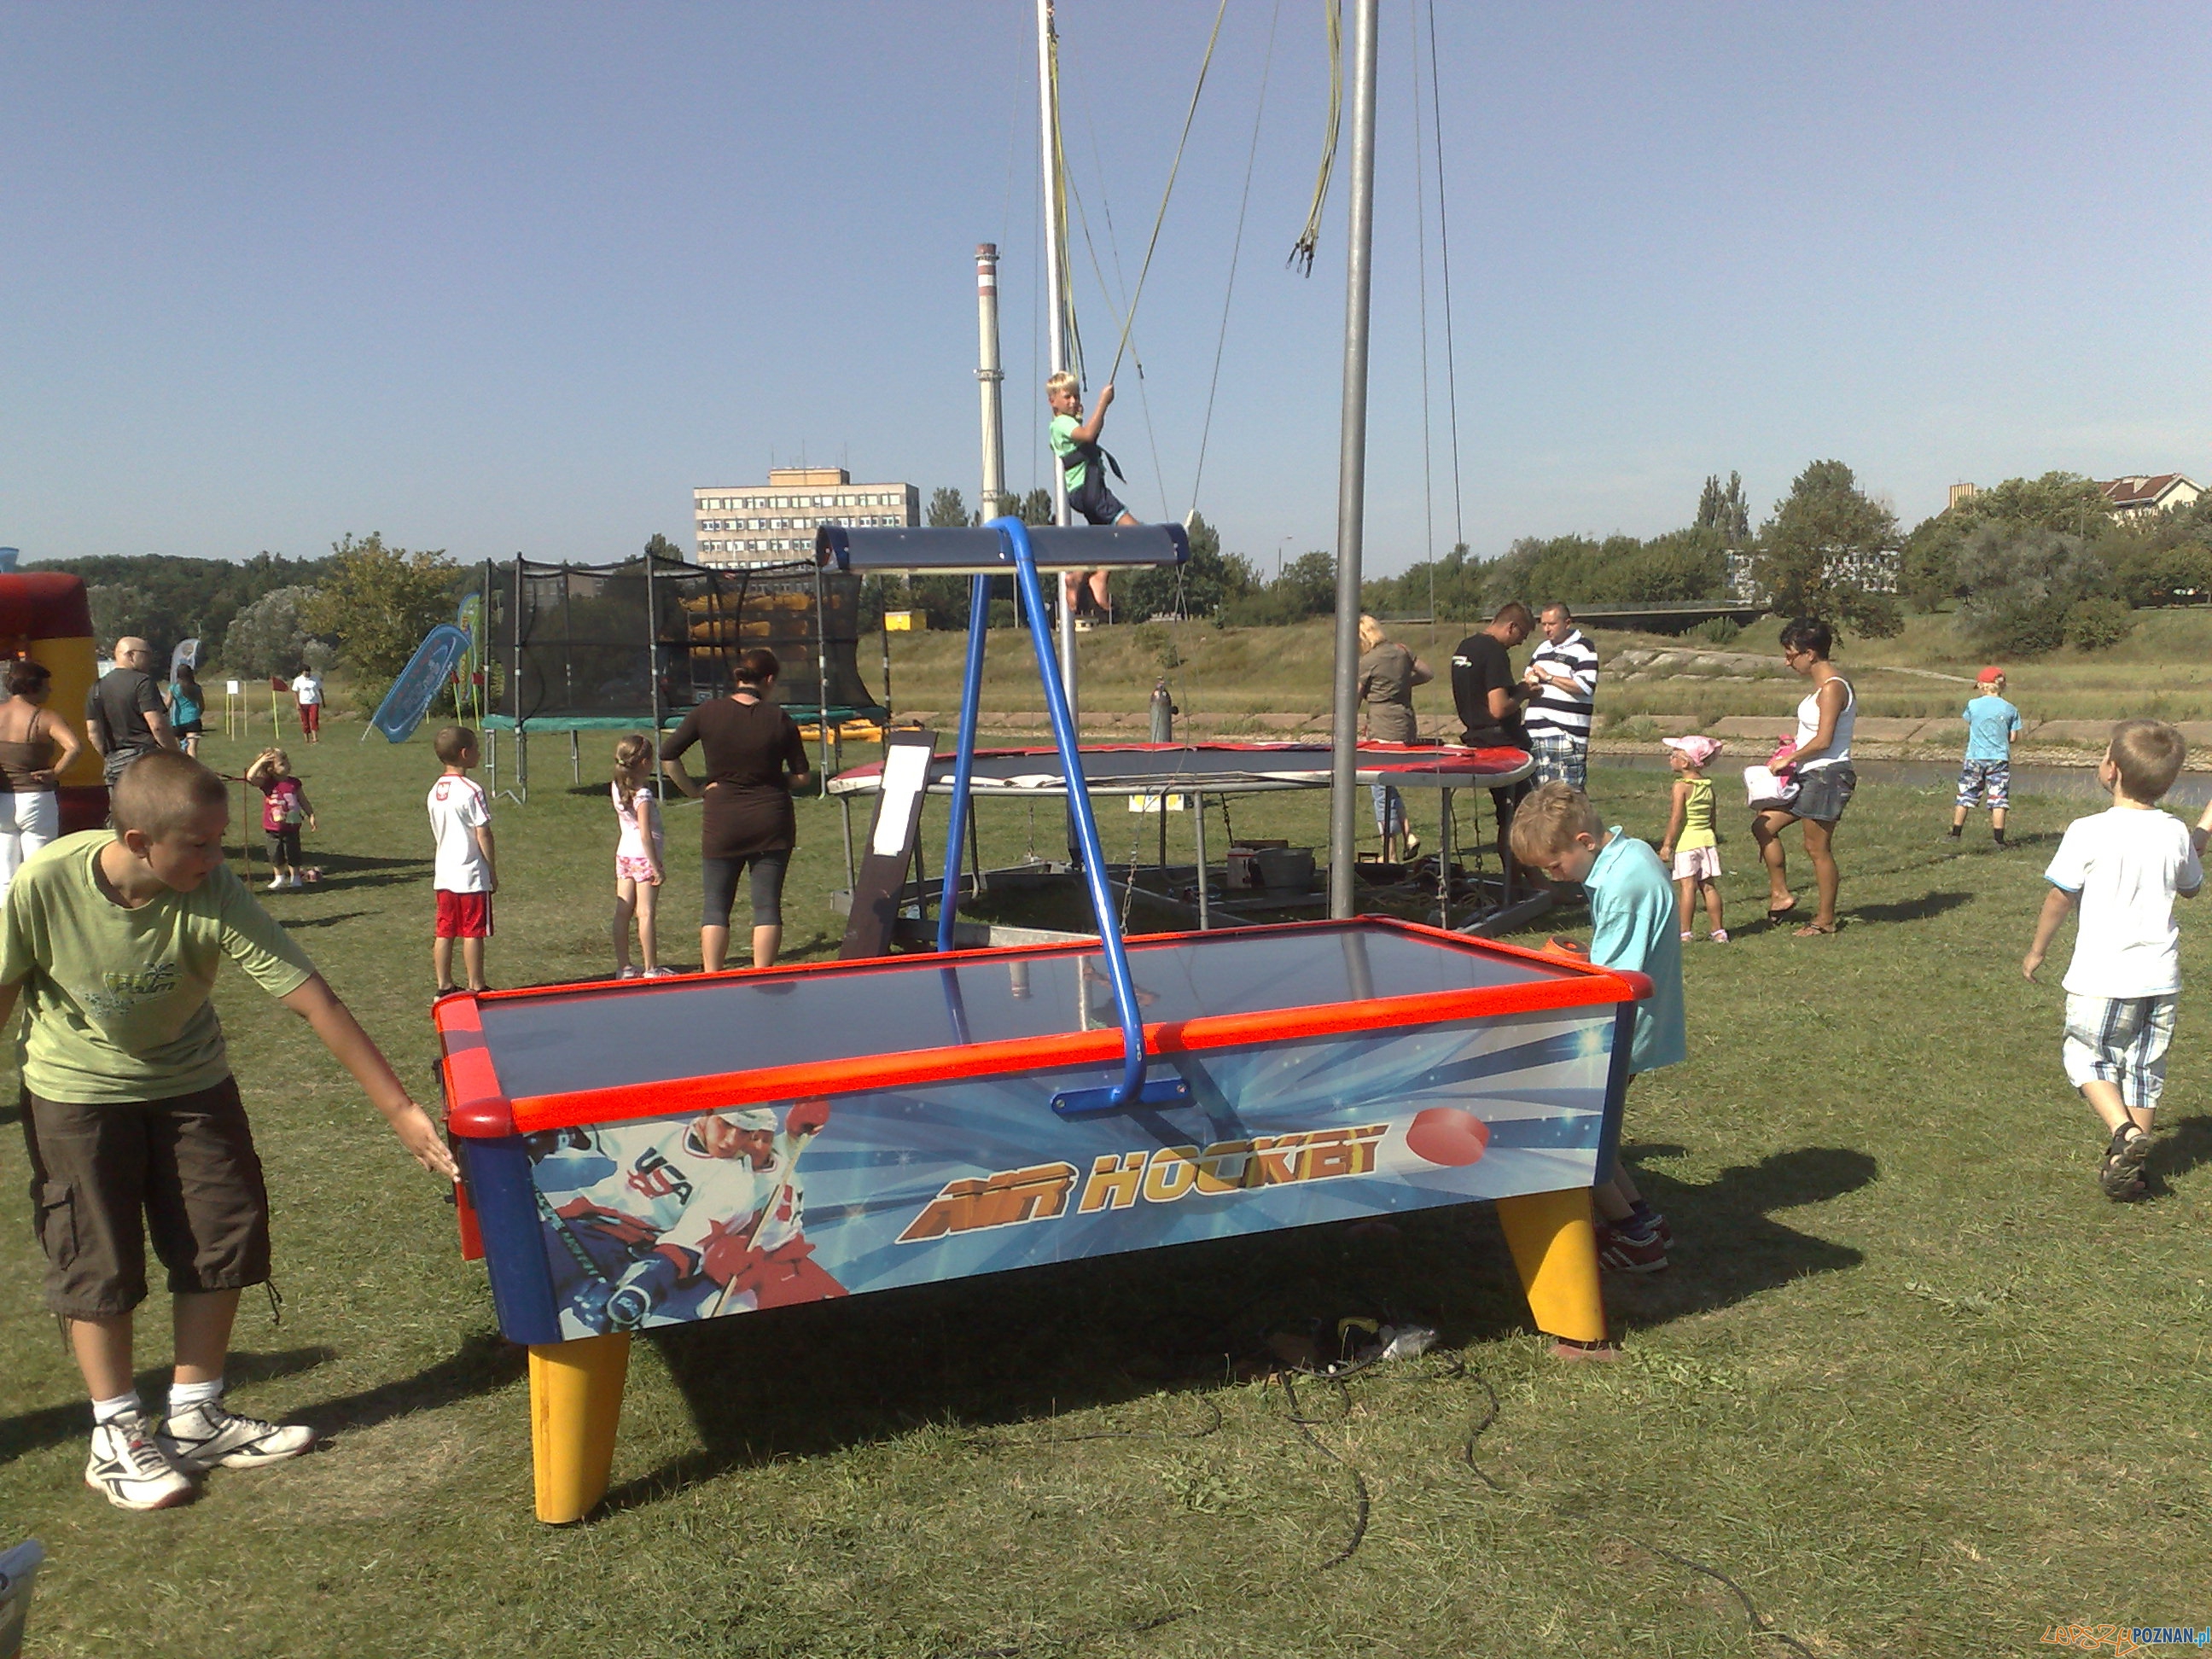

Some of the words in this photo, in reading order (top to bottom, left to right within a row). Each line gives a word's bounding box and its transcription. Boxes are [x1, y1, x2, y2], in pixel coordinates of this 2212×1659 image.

[631, 1146, 693, 1206] USA
[895, 1161, 1079, 1243] AIR
[1077, 1123, 1392, 1214] HOCKEY
